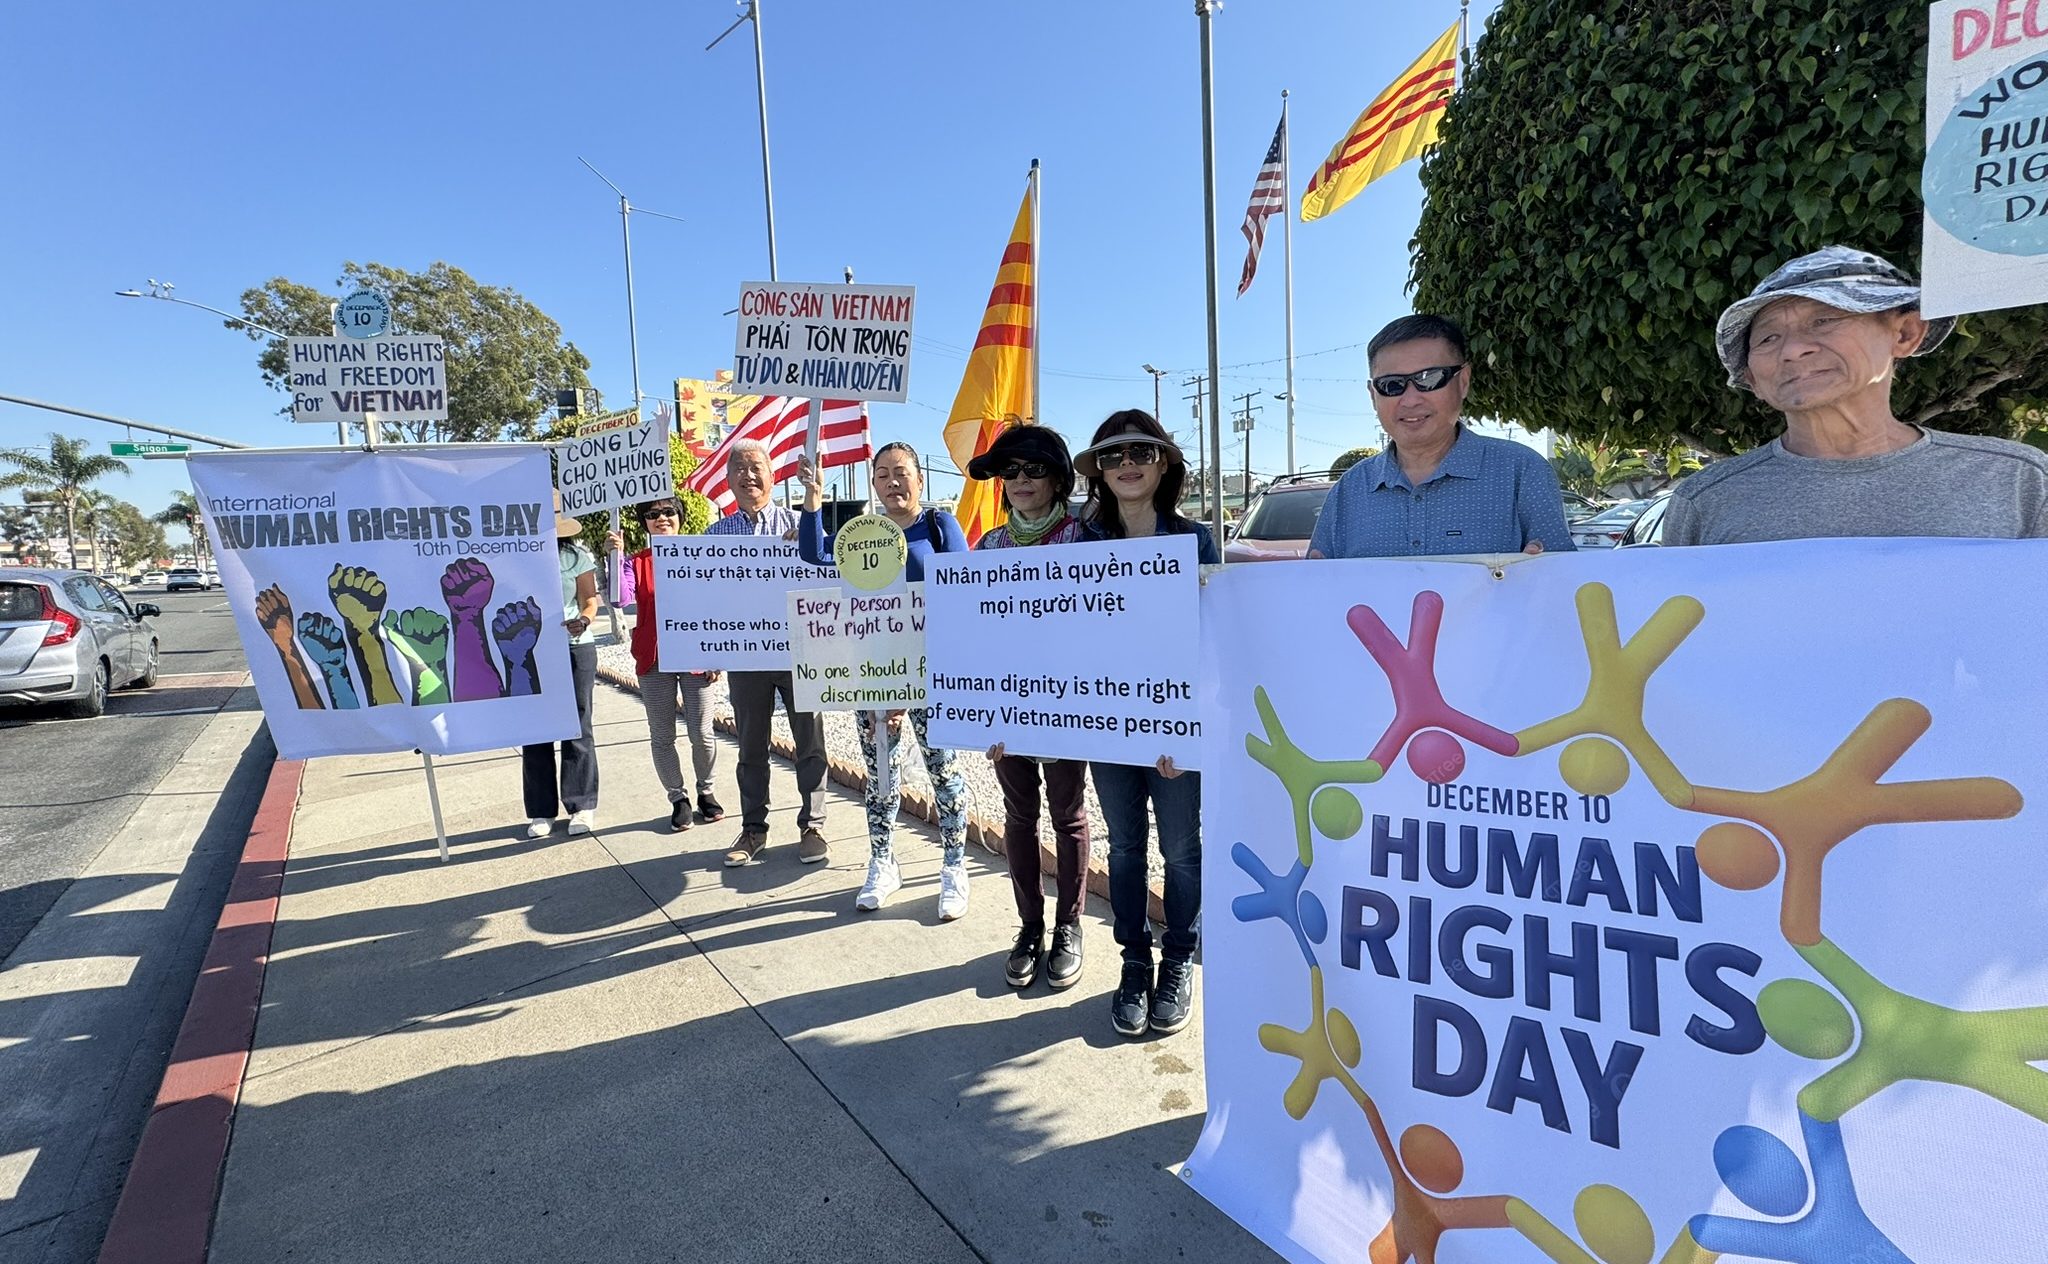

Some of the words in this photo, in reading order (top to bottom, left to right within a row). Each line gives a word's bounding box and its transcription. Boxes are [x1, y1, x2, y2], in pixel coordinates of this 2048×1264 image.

[1980, 116, 2048, 157] HU
[741, 288, 787, 320] CỘNG
[790, 286, 824, 318] SẢN
[354, 312, 371, 326] 10
[294, 343, 366, 363] HUMAN
[805, 325, 847, 353] TÔN
[852, 327, 909, 359] TRỌNG
[293, 368, 326, 386] and
[341, 366, 435, 386] FREEDOM
[759, 356, 783, 385] DO
[785, 363, 799, 384] &
[801, 356, 850, 388] NHÂN
[294, 392, 323, 412] for
[580, 418, 624, 436] DECEMBER
[625, 413, 638, 428] 10
[133, 444, 168, 454] Saigon
[567, 434, 621, 462] CÔNG
[629, 421, 651, 448] LÝ
[562, 463, 597, 485] CHO
[604, 449, 665, 477] NHỮNG
[614, 476, 637, 499] VÔ
[207, 492, 336, 512] International
[211, 511, 339, 550] HUMAN
[348, 506, 471, 542] RIGHTS
[481, 503, 542, 537] DAY
[412, 541, 451, 556] 10th
[458, 539, 546, 556] December
[654, 543, 679, 557] Trả
[684, 546, 702, 560] tự
[706, 544, 726, 558] do
[730, 544, 758, 558] cho
[837, 535, 846, 565] WORLD
[845, 519, 875, 534] HUMAN
[847, 538, 894, 552] DECEMBER
[862, 553, 879, 570] 10
[936, 566, 981, 585] Nhân
[987, 560, 1040, 588] phẩm
[1046, 561, 1063, 580] là
[1068, 553, 1133, 585] quyền
[1139, 553, 1181, 577] của
[667, 566, 691, 579] nói
[695, 567, 715, 581] sự
[720, 566, 751, 582] thật
[755, 566, 775, 581] tại
[797, 599, 840, 620] Every
[980, 596, 1013, 619] mọi
[1019, 593, 1077, 618] người
[1082, 592, 1125, 617] Việt
[665, 619, 698, 631] Free
[702, 618, 745, 631] those
[749, 618, 780, 631] who
[807, 620, 835, 638] the
[845, 616, 881, 640] right
[887, 616, 904, 633] to
[700, 640, 739, 652] truth
[744, 640, 757, 651] in
[761, 640, 790, 652] Viet
[797, 663, 817, 680] No
[825, 666, 850, 679] one
[860, 658, 907, 677] should
[820, 682, 926, 703] discriminatio
[932, 673, 995, 692] Human
[1000, 674, 1068, 699] dignity
[1073, 676, 1089, 695] is
[1095, 677, 1130, 697] the
[1136, 678, 1191, 704] right
[926, 703, 943, 719] of
[946, 705, 995, 728] every
[1000, 706, 1118, 731] Vietnamese
[1124, 717, 1202, 738] person
[1427, 781, 1568, 821] DECEMBER
[1579, 794, 1611, 823] 10
[1370, 815, 1703, 923] HUMAN
[1340, 885, 1767, 1055] RIGHTS
[1412, 994, 1645, 1149] DAY
